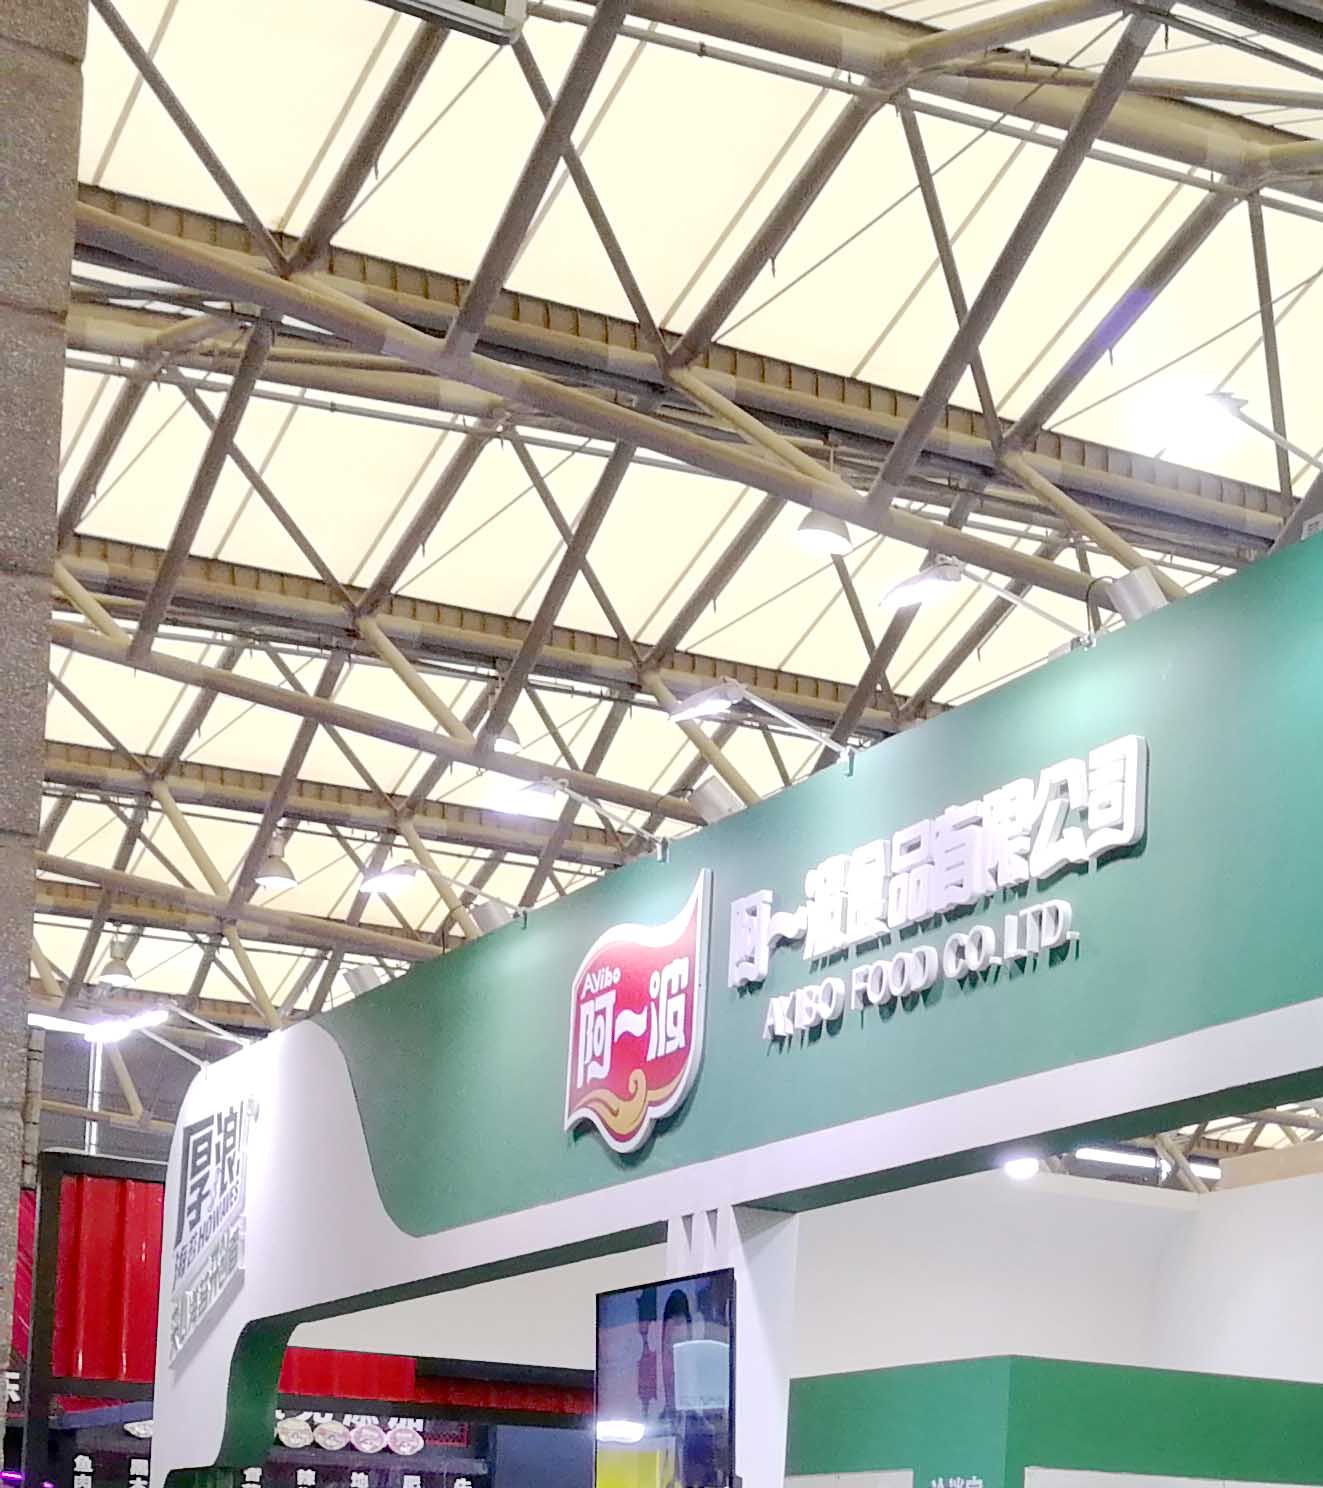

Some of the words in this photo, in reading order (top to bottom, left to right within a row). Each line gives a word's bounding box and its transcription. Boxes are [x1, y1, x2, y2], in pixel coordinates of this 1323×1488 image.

[576, 956, 690, 1090] 阿一波
[851, 945, 939, 1011] FOOD
